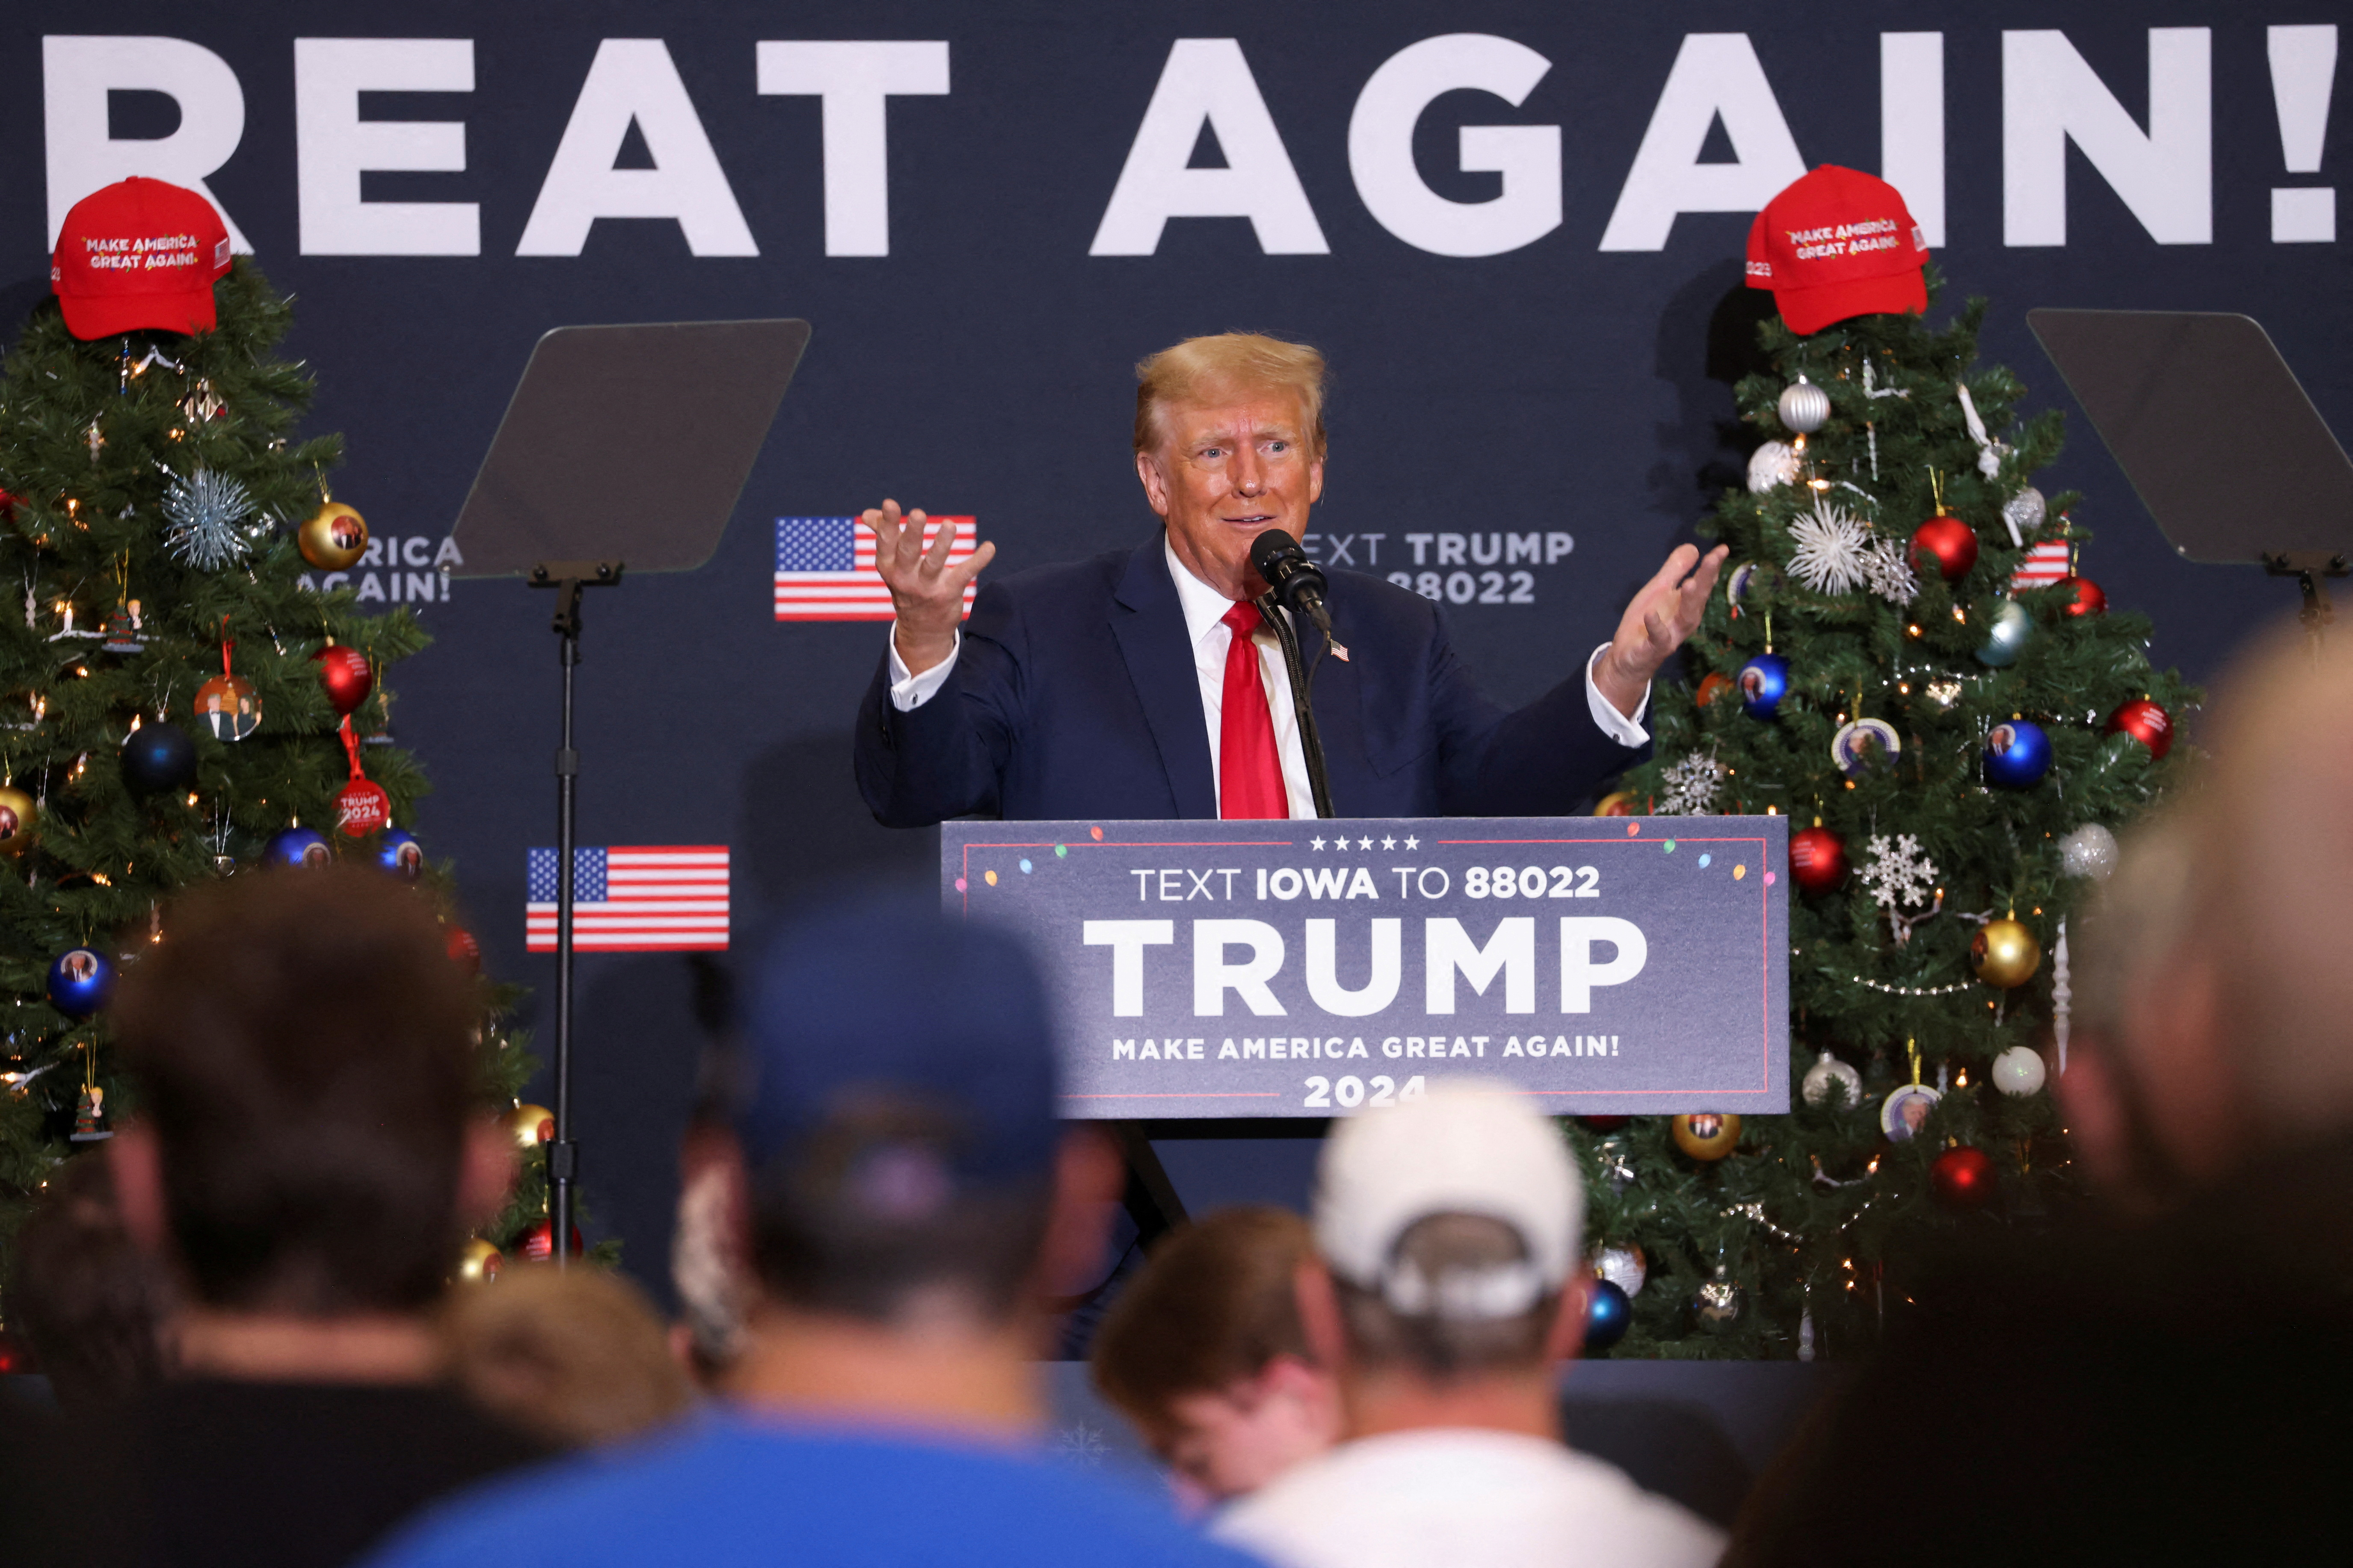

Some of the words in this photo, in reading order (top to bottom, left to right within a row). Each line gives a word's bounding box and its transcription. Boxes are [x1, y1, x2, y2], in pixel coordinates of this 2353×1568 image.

[42, 35, 950, 257] REAT
[1089, 24, 2337, 257] AGAIN!
[86, 238, 130, 251] MAKE
[132, 235, 197, 251] AMERICA
[1790, 227, 1834, 245] MAKE
[1835, 219, 1897, 238] AMERICA
[90, 255, 142, 268] GREAT
[144, 252, 194, 268] AGAIN!
[1796, 242, 1846, 260] GREAT
[1848, 236, 1897, 253] AGAIN!
[1746, 261, 1772, 277] 023
[357, 536, 463, 567] RICA
[1301, 533, 1387, 566] EXT
[1405, 532, 1575, 566] TRUMP
[341, 795, 379, 808] TRUMP
[342, 805, 380, 820] 2024
[1130, 868, 1242, 901] TEXT
[1256, 867, 1379, 900] IOWA
[1391, 867, 1450, 899] TO
[1465, 866, 1600, 899] 88022
[1083, 916, 1648, 1017] TRUMP
[1113, 1038, 1205, 1060] MAKE
[1217, 1037, 1369, 1060] AMERICA
[1382, 1036, 1490, 1059] GREAT
[1502, 1035, 1619, 1058] AGAIN!
[1304, 1075, 1428, 1108] 2024
